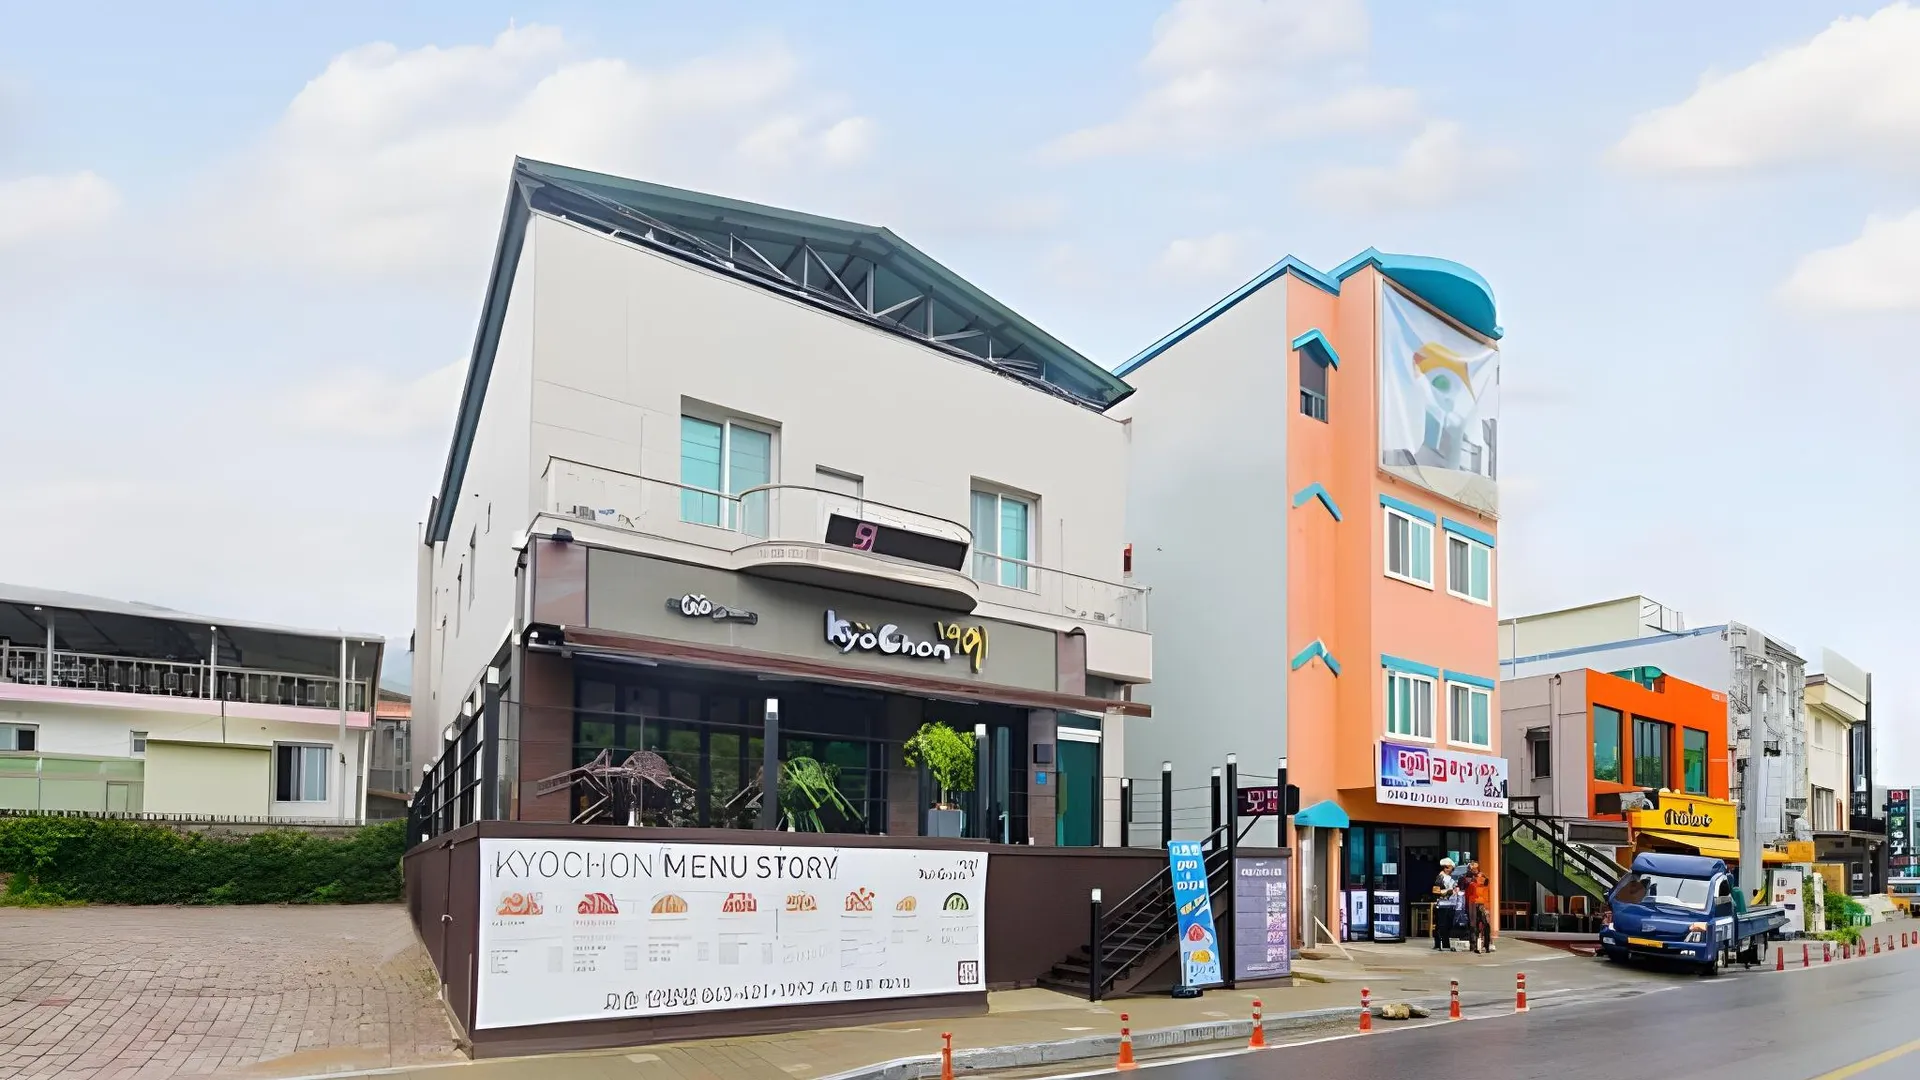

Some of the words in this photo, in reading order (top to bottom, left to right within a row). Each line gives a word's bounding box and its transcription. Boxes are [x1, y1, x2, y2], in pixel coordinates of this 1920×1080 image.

[495, 849, 653, 878] KYOCHON
[664, 853, 747, 879] MENU
[756, 855, 838, 880] STORY
